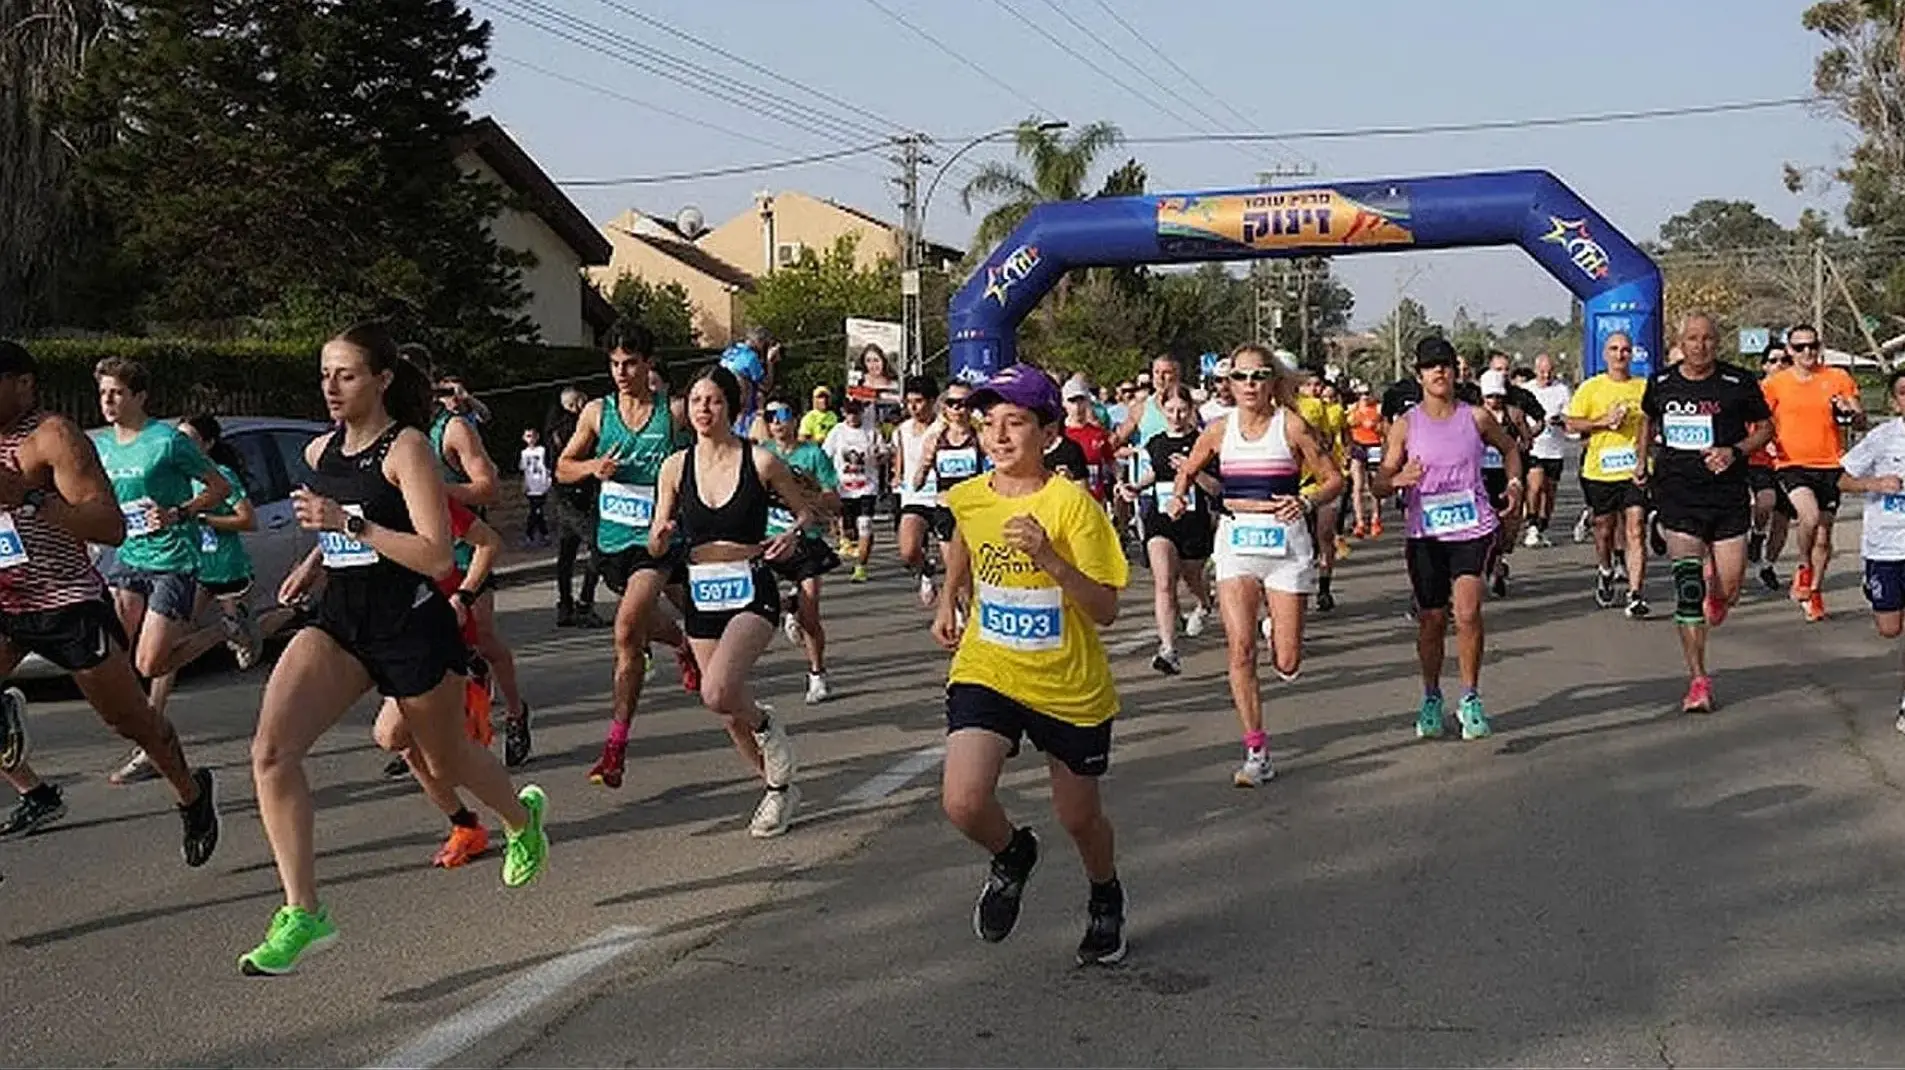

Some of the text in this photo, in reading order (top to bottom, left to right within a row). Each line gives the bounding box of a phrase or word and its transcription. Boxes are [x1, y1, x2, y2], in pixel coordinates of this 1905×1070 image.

[1243, 208, 1331, 243] זינוק
[699, 580, 744, 601] 5077
[987, 606, 1051, 637] 5093
